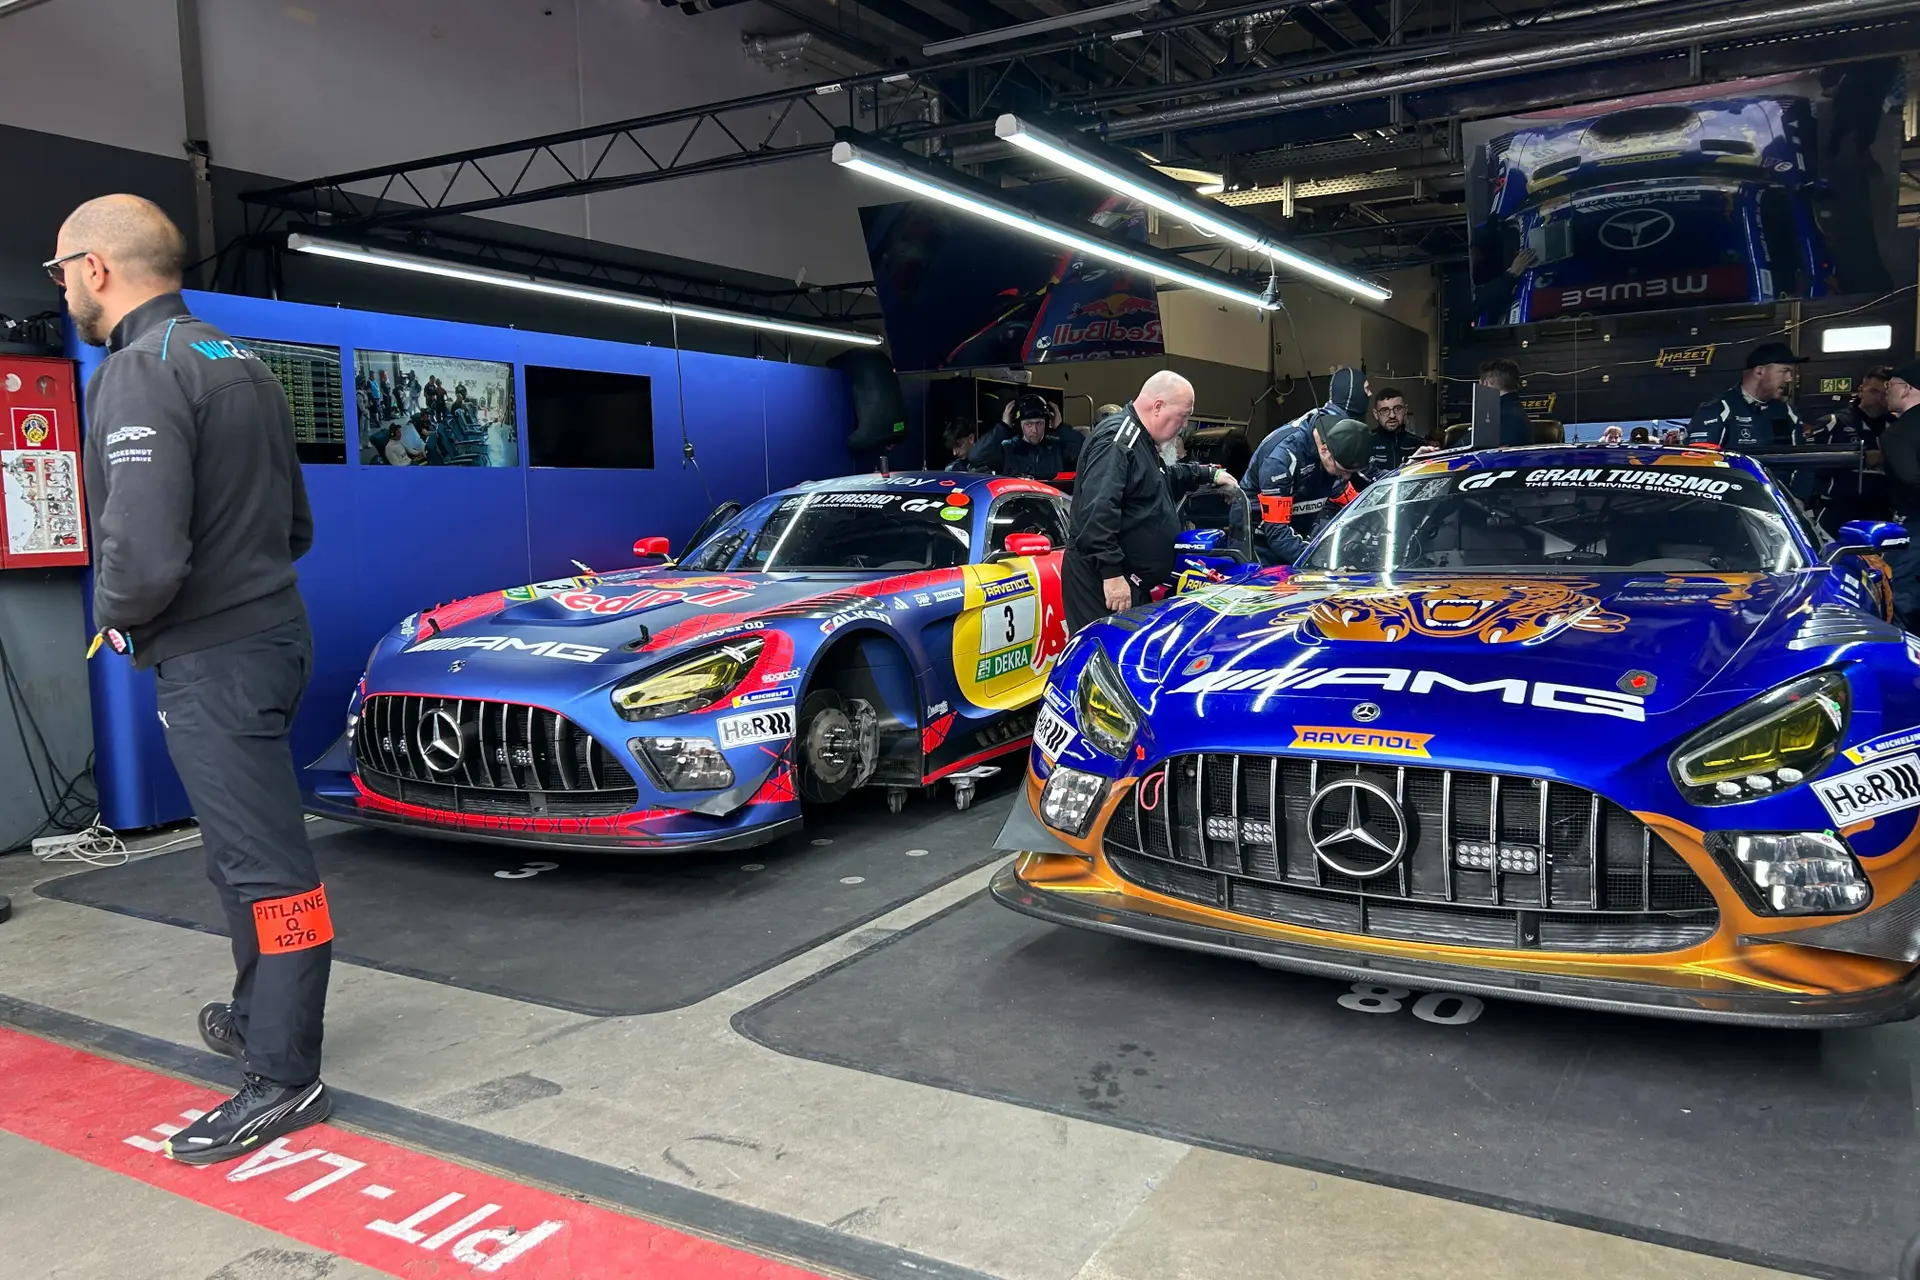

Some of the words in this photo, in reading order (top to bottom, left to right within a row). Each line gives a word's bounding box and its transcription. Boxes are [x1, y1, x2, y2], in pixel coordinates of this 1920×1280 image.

[1662, 350, 1708, 363] HAZET
[1520, 399, 1550, 408] AZET
[1525, 468, 1603, 482] GRAN
[1588, 481, 1642, 490] DRIVING
[1644, 484, 1723, 500] SIMULATOR
[985, 578, 1030, 597] RAVENOL
[819, 610, 893, 635] FALKEN
[1004, 605, 1015, 642] 3
[461, 636, 611, 663] AMG
[994, 647, 1029, 675] DEKRA
[751, 690, 790, 700] MICHELIN
[1306, 668, 1646, 722] AMG
[723, 717, 768, 742] H&R
[1301, 731, 1419, 751] RAVENOL
[1824, 773, 1895, 813] H&R
[493, 861, 560, 879] 3
[255, 893, 324, 920] PITLANE
[285, 917, 300, 931] Q
[274, 929, 317, 947] 1276
[1336, 982, 1485, 1025] 80
